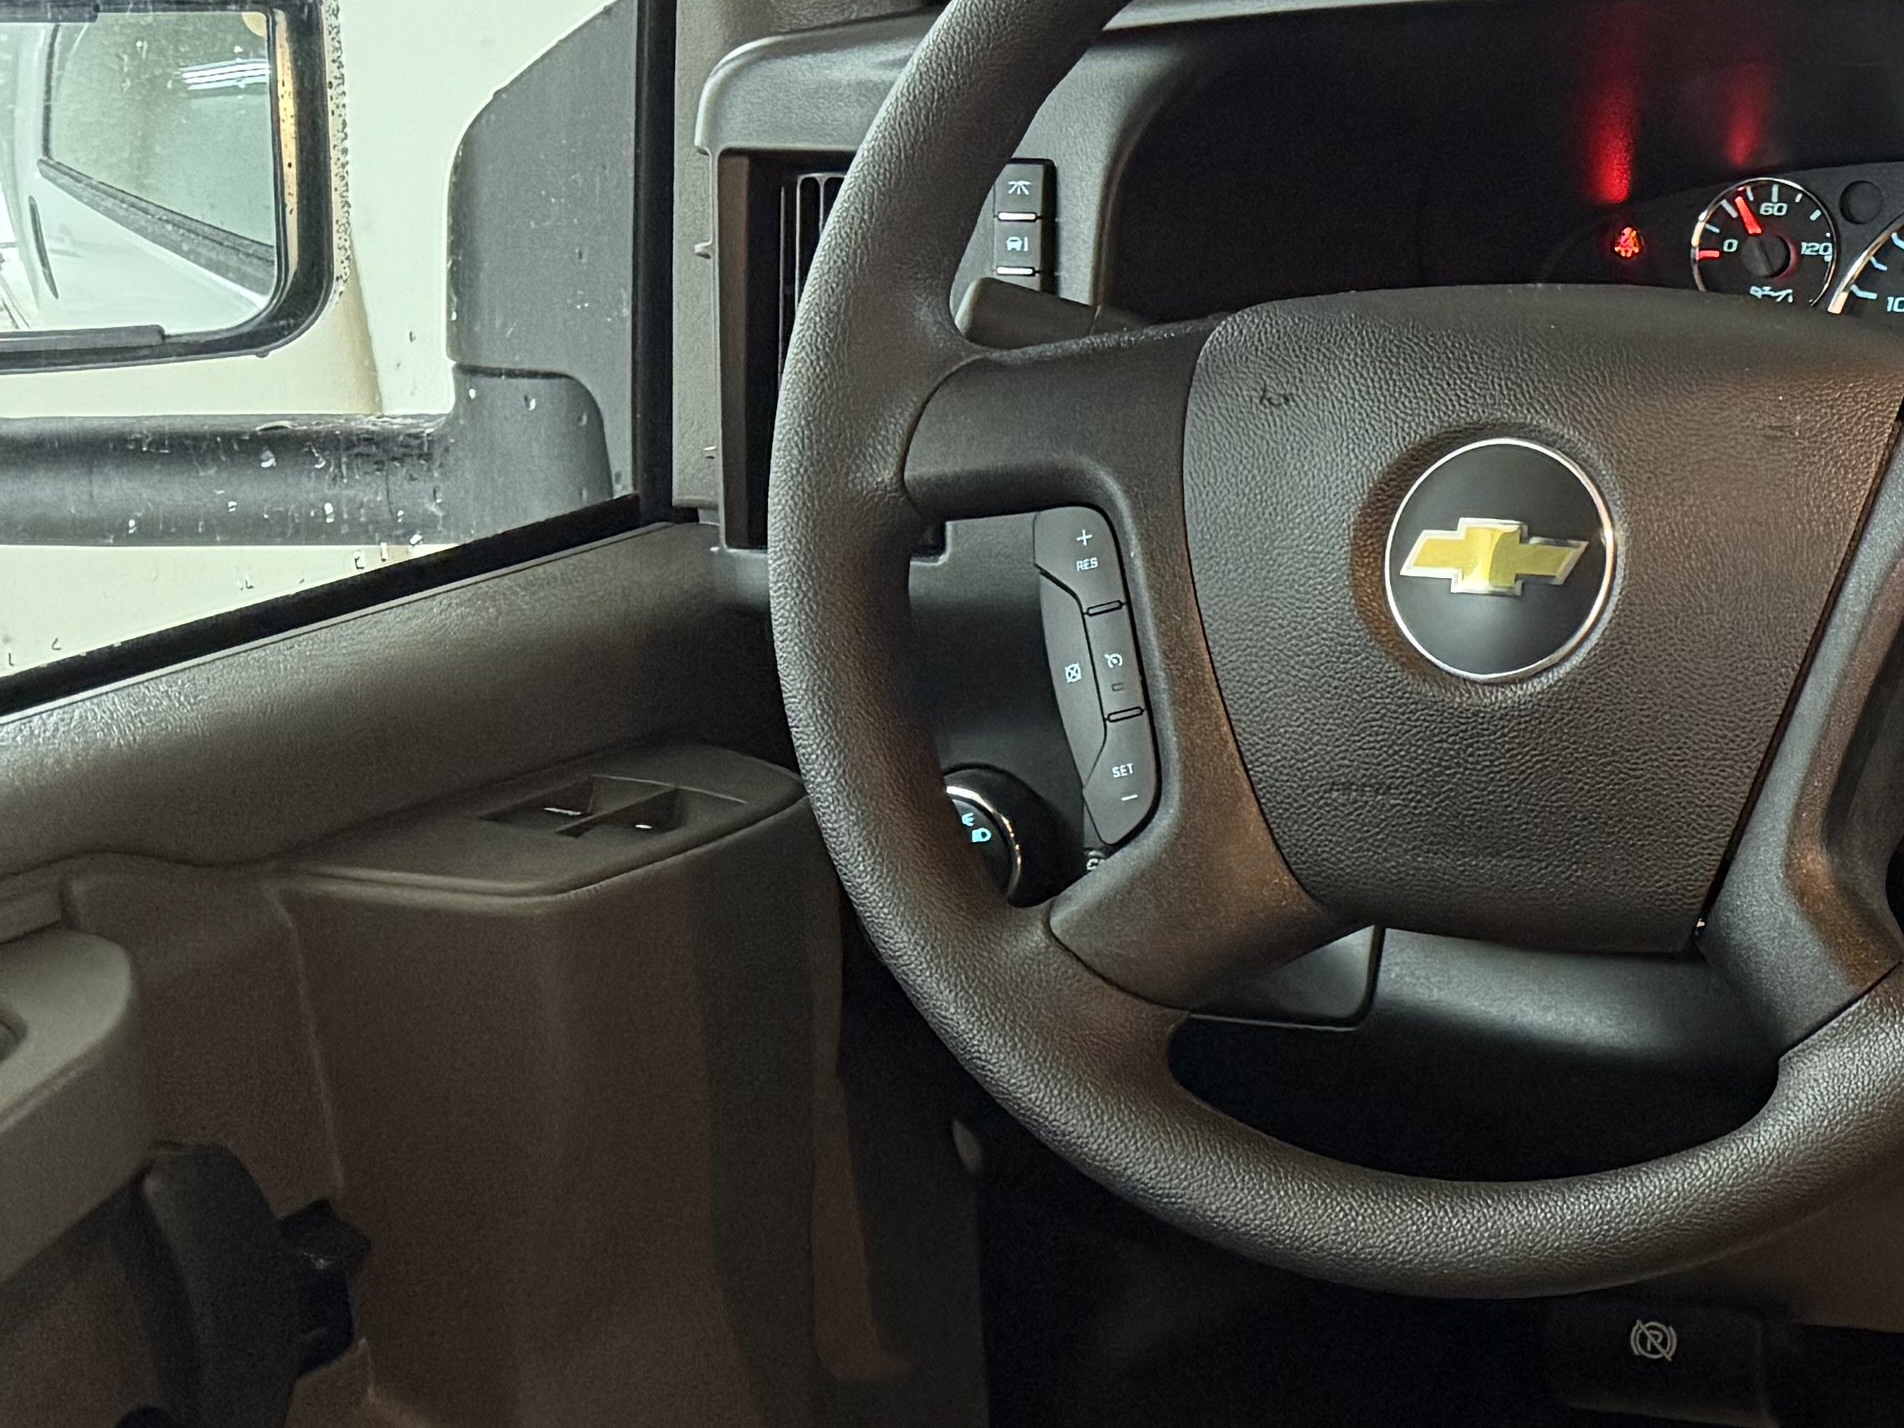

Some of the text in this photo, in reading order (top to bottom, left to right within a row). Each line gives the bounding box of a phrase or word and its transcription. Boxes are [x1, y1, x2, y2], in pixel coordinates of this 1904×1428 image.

[1760, 202, 1787, 216] 60
[1723, 238, 1739, 253] 0
[1800, 241, 1832, 256] 120
[1076, 556, 1099, 573] RES
[1112, 762, 1135, 779] SET
